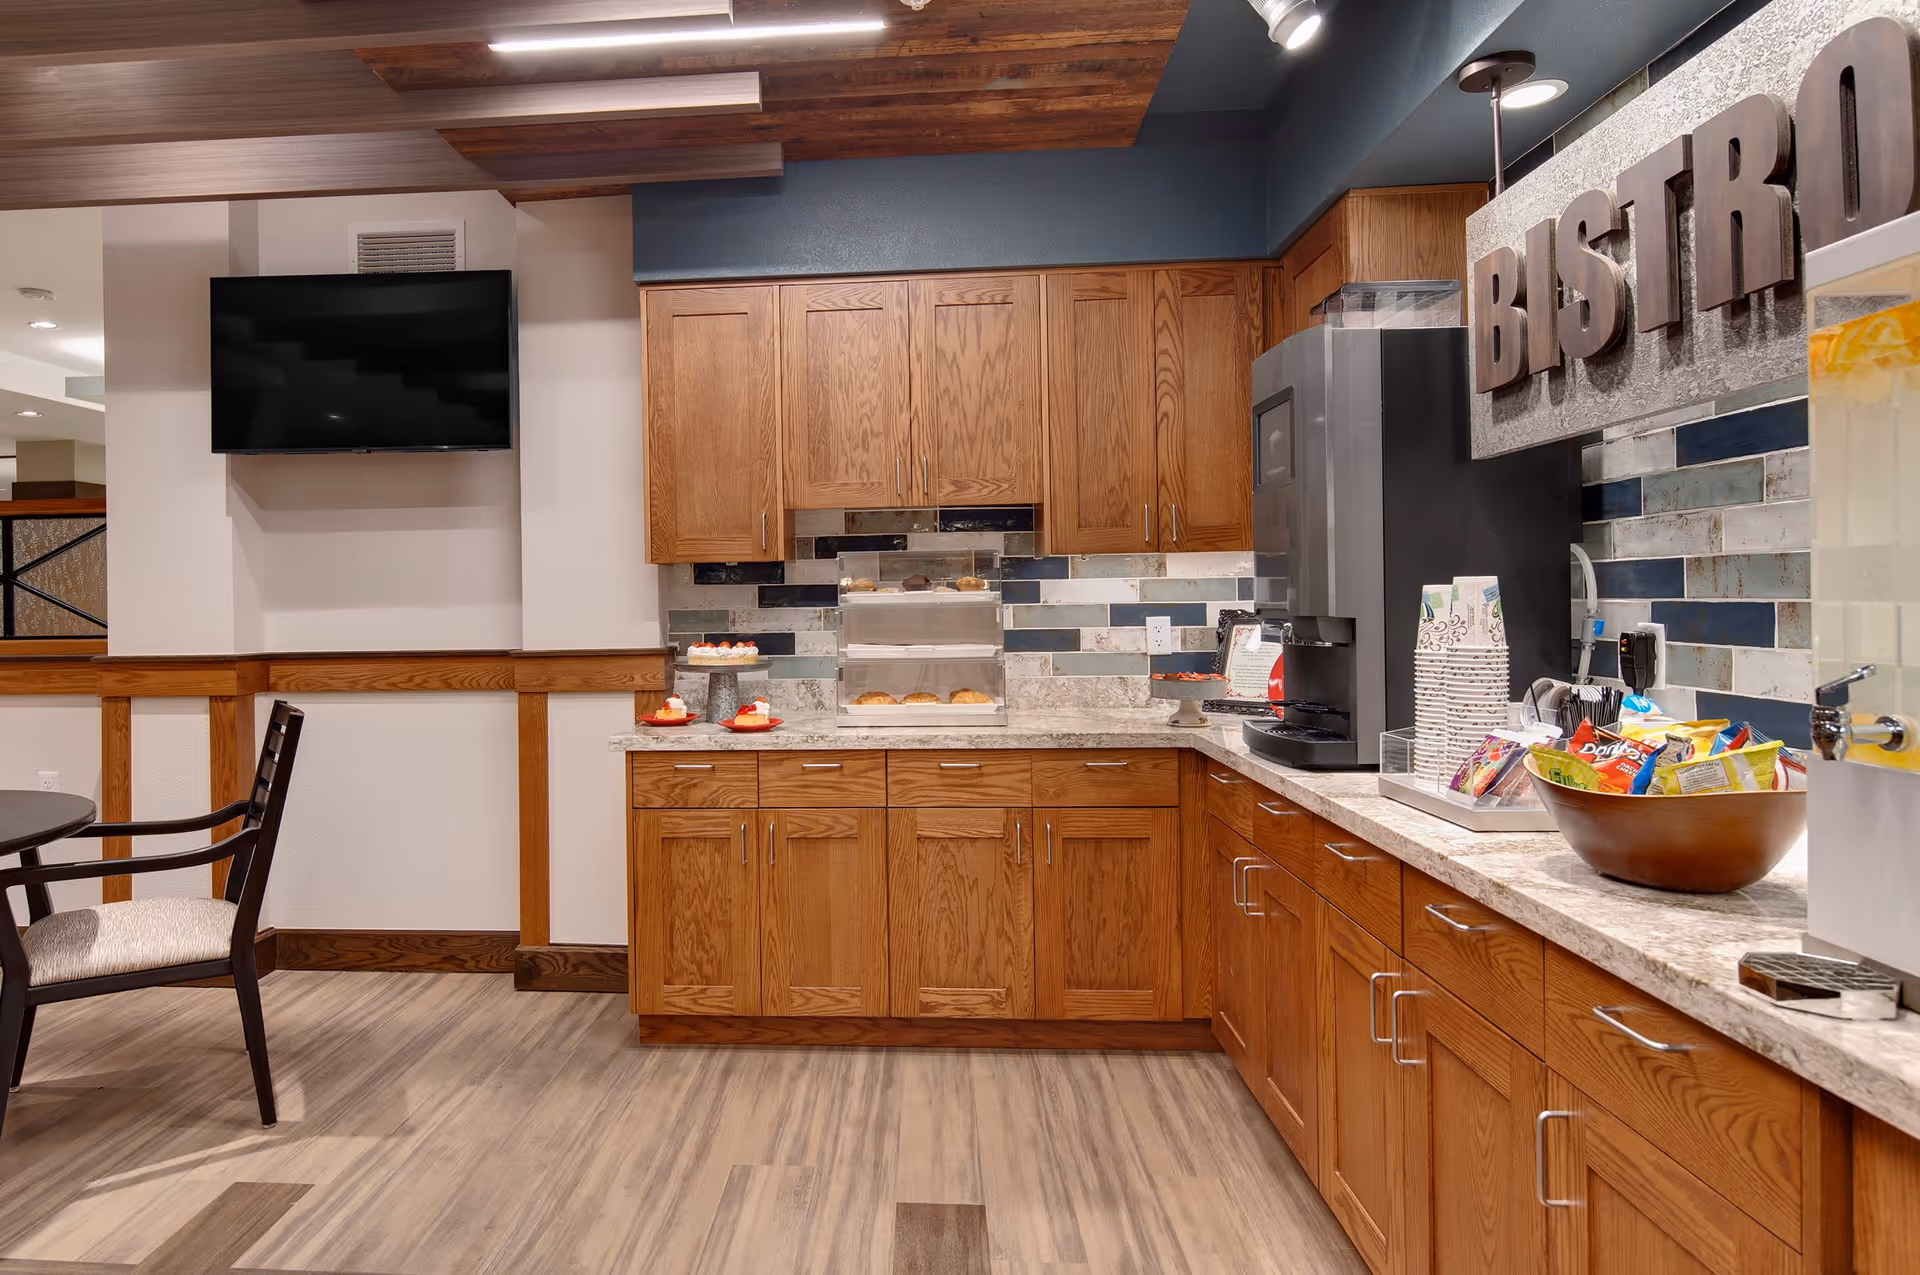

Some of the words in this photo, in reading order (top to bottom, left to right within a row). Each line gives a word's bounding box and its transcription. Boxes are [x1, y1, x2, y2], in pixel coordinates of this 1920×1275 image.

[1474, 16, 1920, 394] BISTRO
[1577, 740, 1649, 766] Doritos
[1620, 762, 1639, 774] NACH
